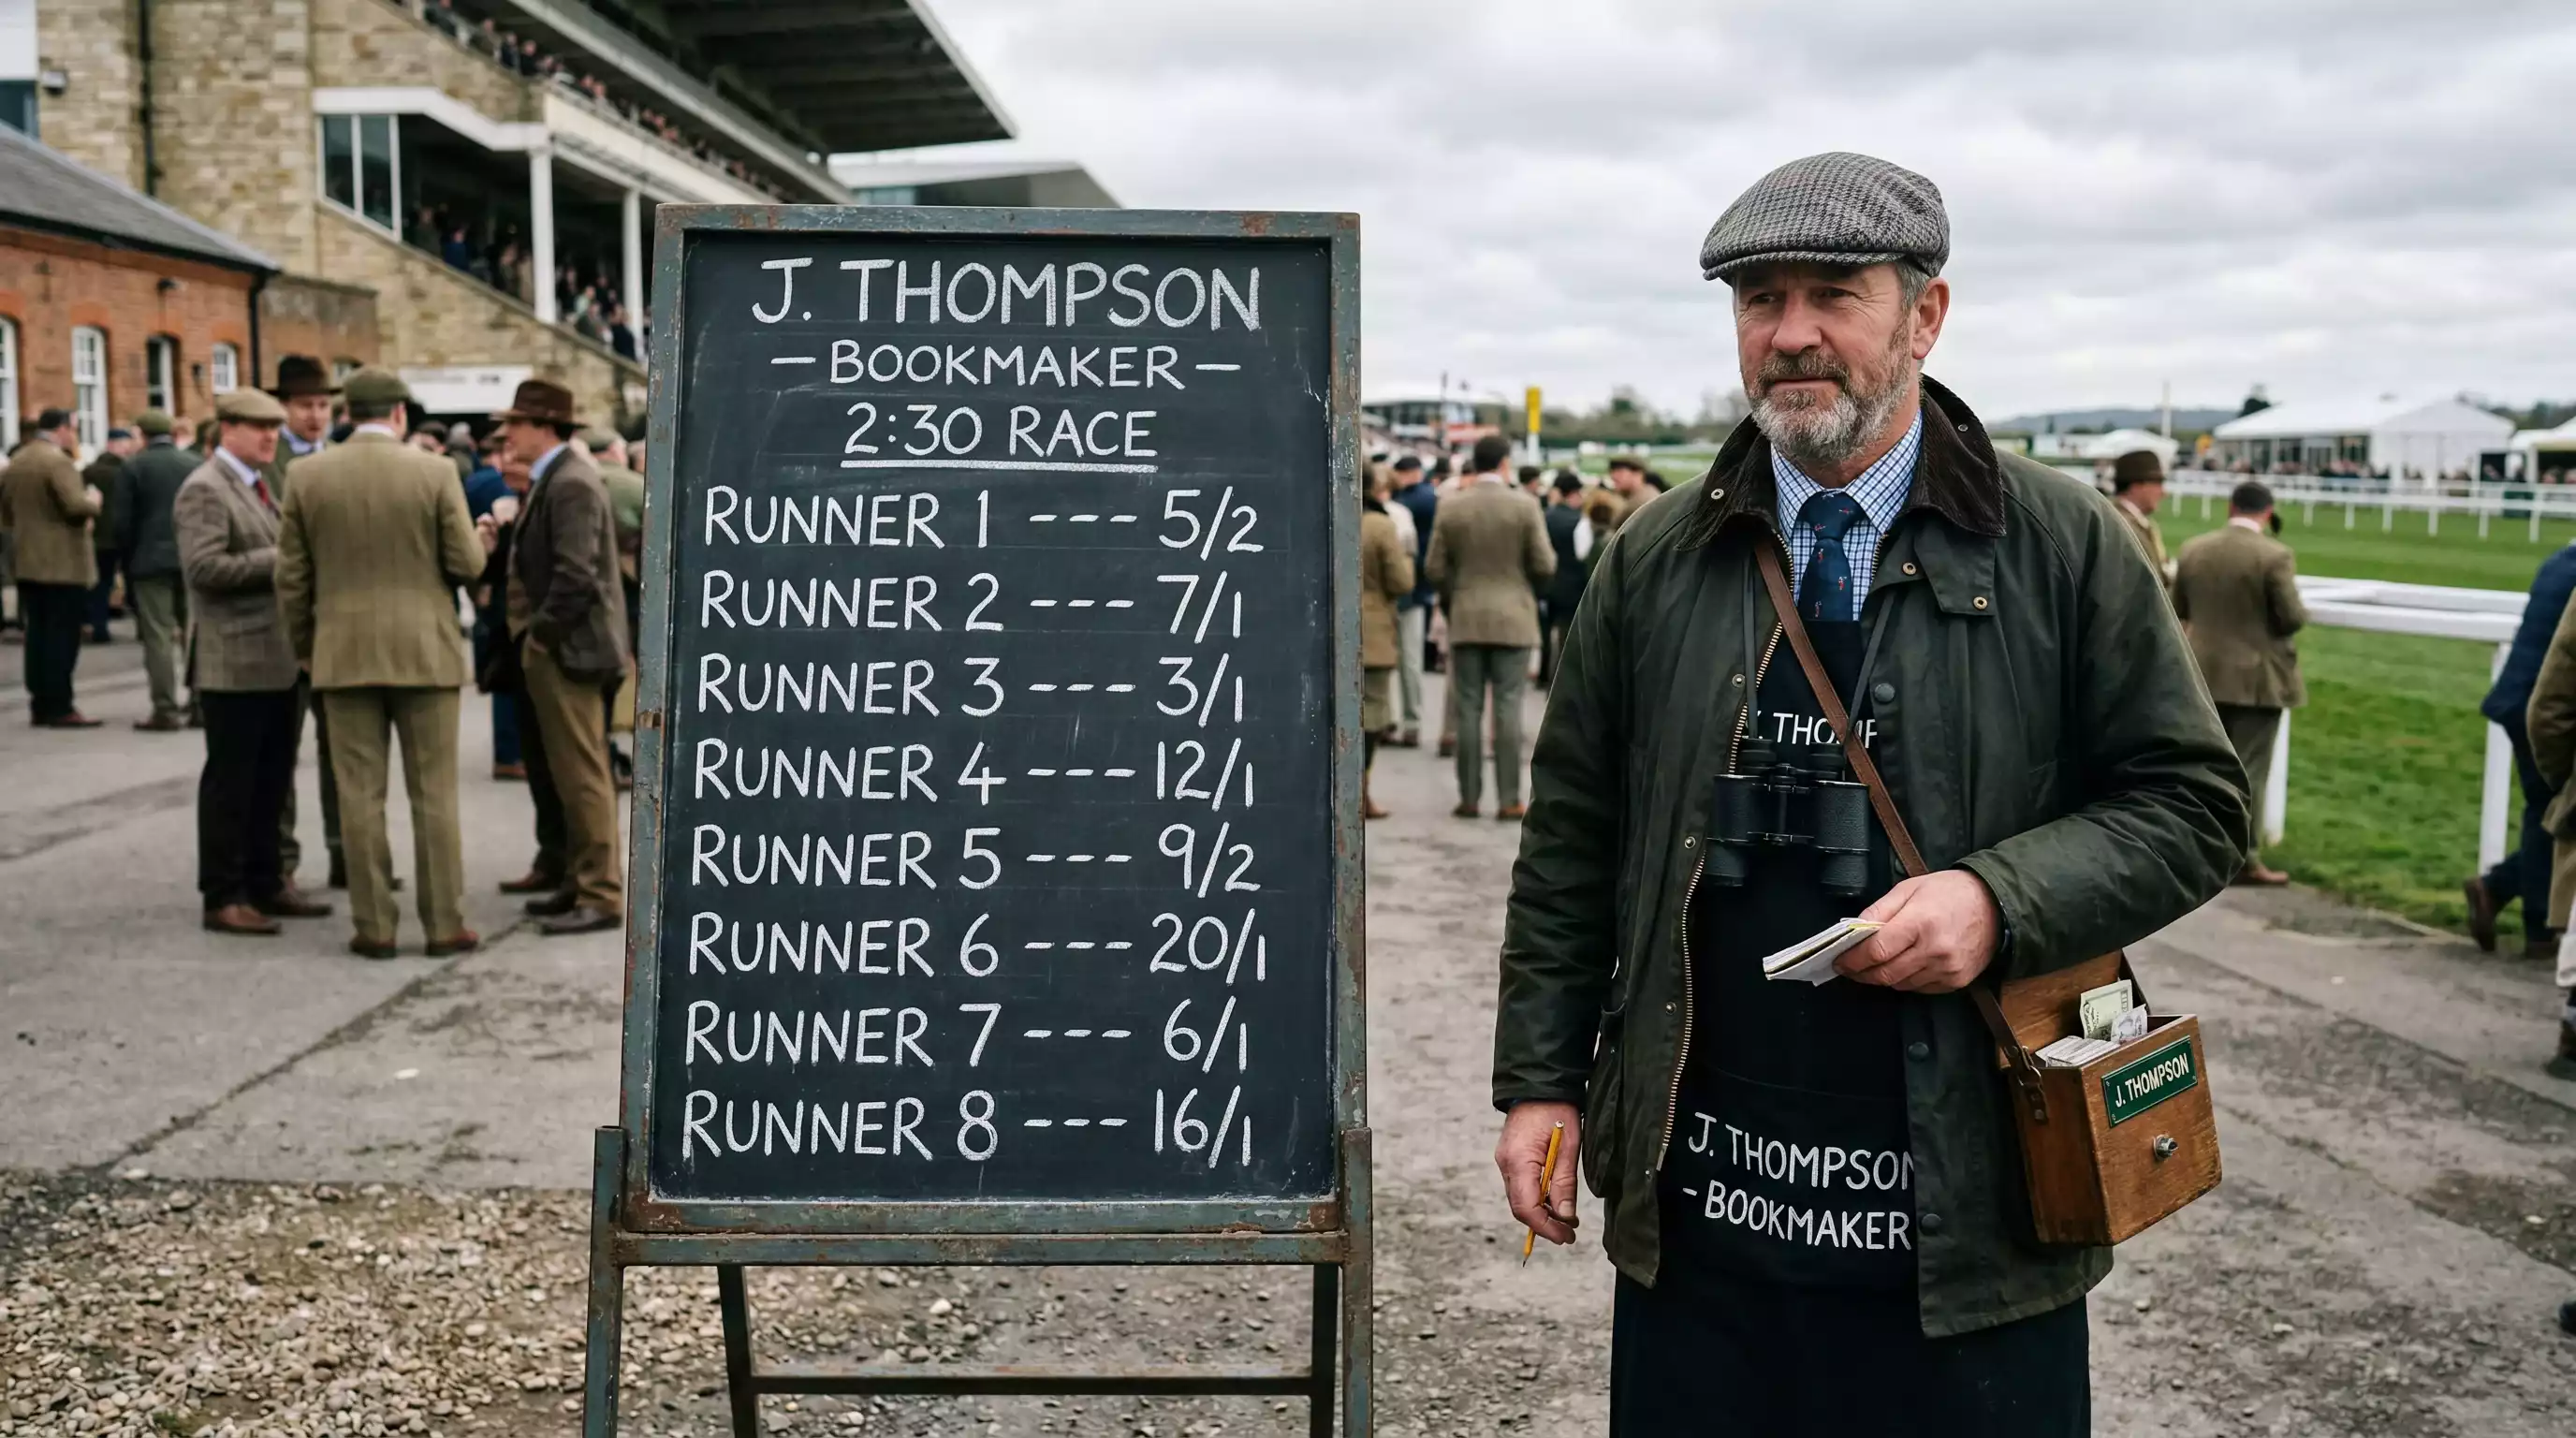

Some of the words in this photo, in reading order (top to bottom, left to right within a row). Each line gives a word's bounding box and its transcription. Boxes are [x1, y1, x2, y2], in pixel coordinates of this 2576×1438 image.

[752, 257, 813, 324] J.
[839, 258, 1262, 332] THOMPSON
[843, 402, 984, 455] 2:30
[1009, 404, 1158, 458] RACE
[705, 486, 944, 548] RUNNER
[976, 489, 988, 549] 1
[1156, 486, 1265, 560] 5/2
[701, 570, 942, 631] RUNNER
[964, 573, 1004, 632] 2
[1156, 571, 1242, 643] 7/1
[698, 653, 940, 716] RUNNER
[960, 657, 1004, 717] 3
[1156, 653, 1244, 727] 3/1
[695, 738, 937, 801] RUNNER
[958, 741, 1007, 806] 4
[1156, 738, 1254, 811] 12/1
[692, 825, 936, 888] RUNNER
[959, 827, 1002, 890] 5
[1158, 822, 1261, 898] 9/2
[689, 912, 934, 976] RUNNER
[959, 913, 999, 977] 6
[1149, 908, 1266, 985] 20/1
[685, 1000, 933, 1066] RUNNER
[959, 1003, 1003, 1067] 7
[1164, 996, 1247, 1073] 6/1
[2115, 1085, 2127, 1108] J.
[2125, 1052, 2189, 1102] THOMPSON
[682, 1090, 933, 1161] RUNNER
[957, 1090, 999, 1161] 8
[1154, 1085, 1251, 1168] 16/1
[1688, 1111, 1717, 1157] J.
